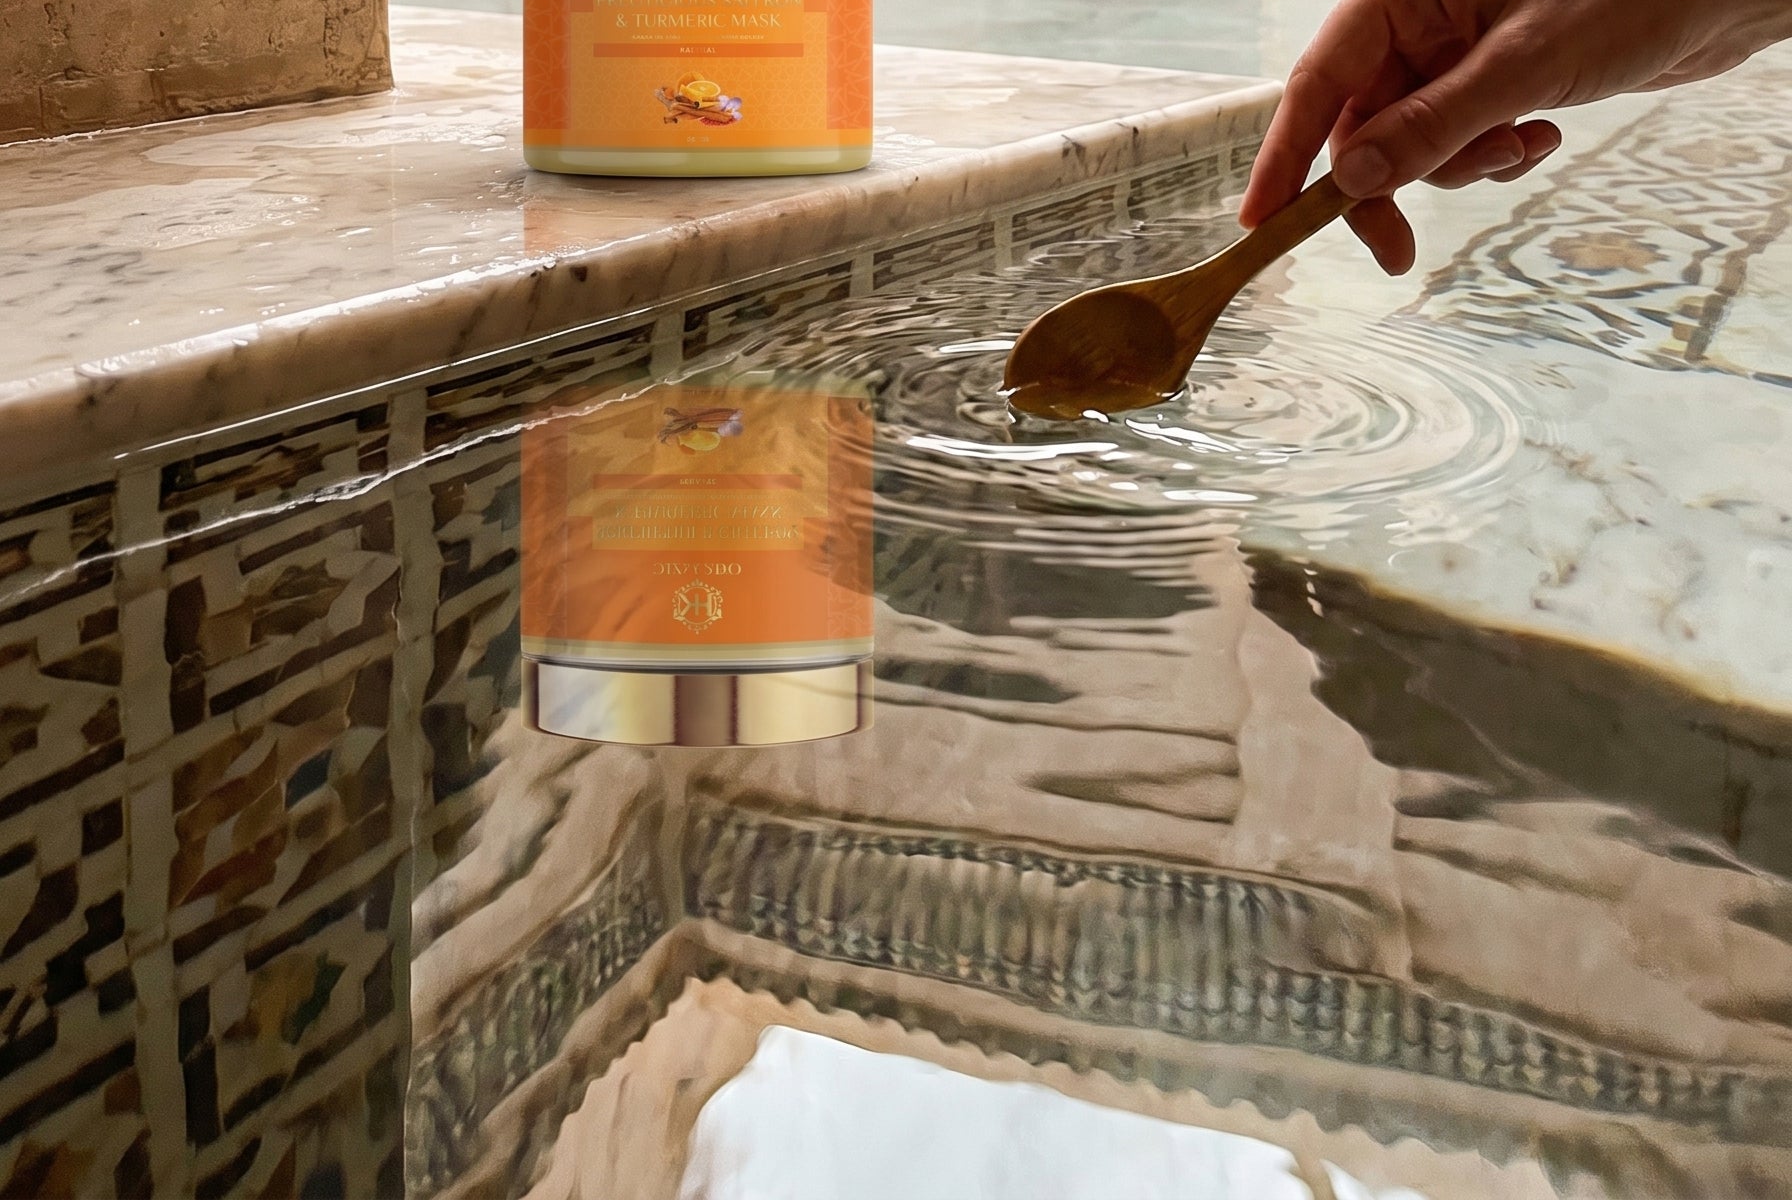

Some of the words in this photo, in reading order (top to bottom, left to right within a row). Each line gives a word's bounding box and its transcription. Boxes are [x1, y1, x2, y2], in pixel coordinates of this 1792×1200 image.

[615, 12, 628, 28] &
[632, 12, 726, 28] TURMERIC
[731, 12, 783, 28] MASK
